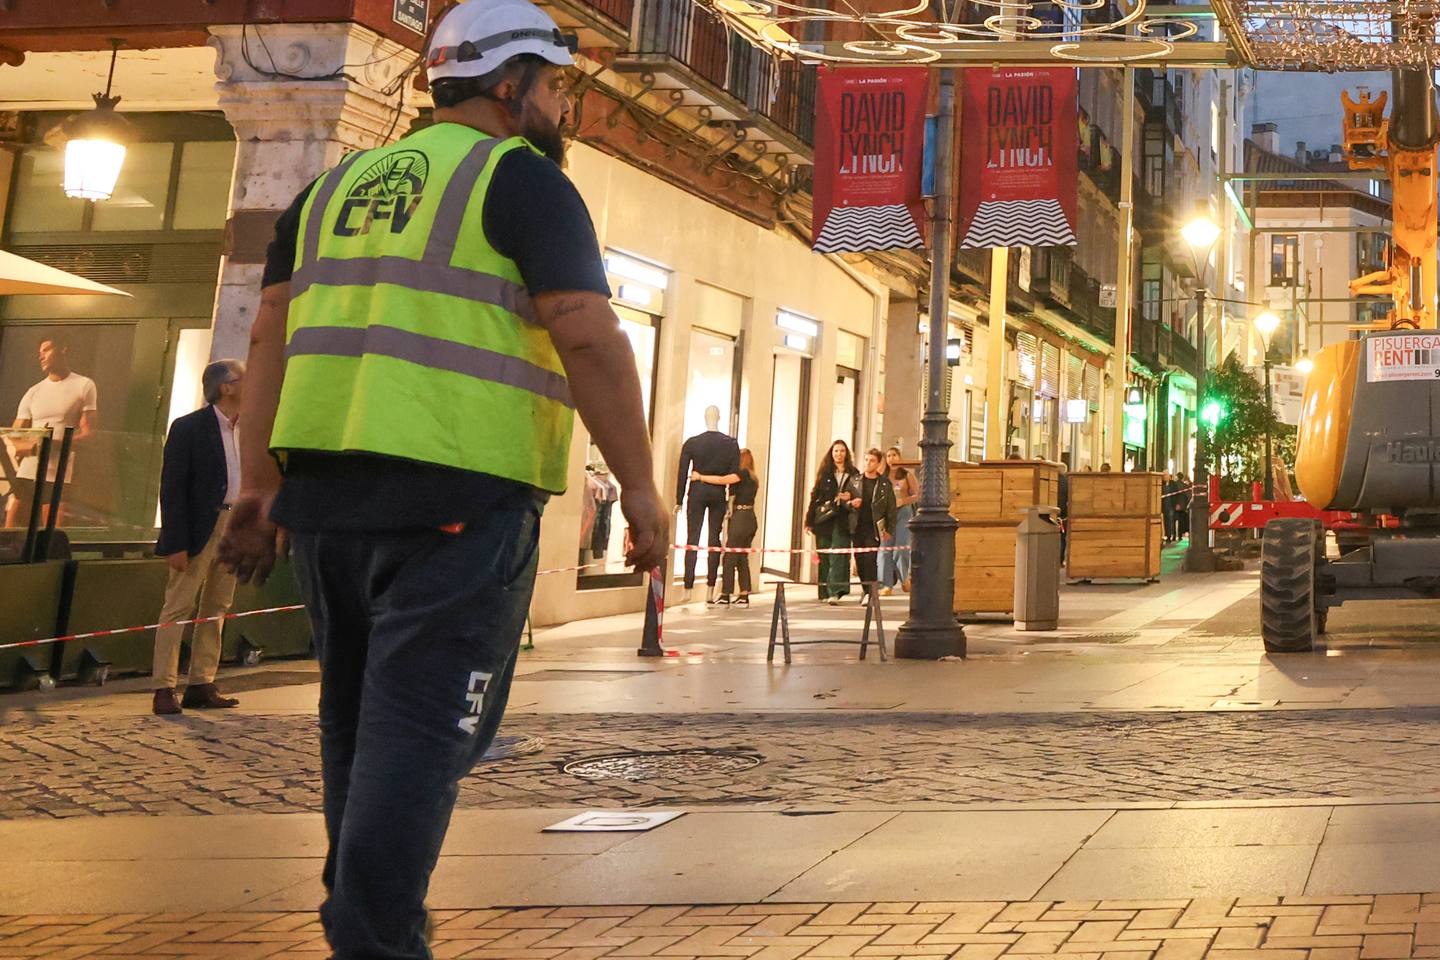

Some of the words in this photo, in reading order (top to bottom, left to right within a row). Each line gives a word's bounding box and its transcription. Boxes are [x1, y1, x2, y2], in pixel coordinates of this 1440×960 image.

[397, 10, 423, 31] SANTIAGO
[841, 91, 905, 133] DAVID
[987, 84, 1054, 127] DAVID
[839, 132, 904, 174] LYNCH
[986, 126, 1054, 168] LYNCH
[333, 196, 423, 237] CFV
[1374, 350, 1414, 367] RENT
